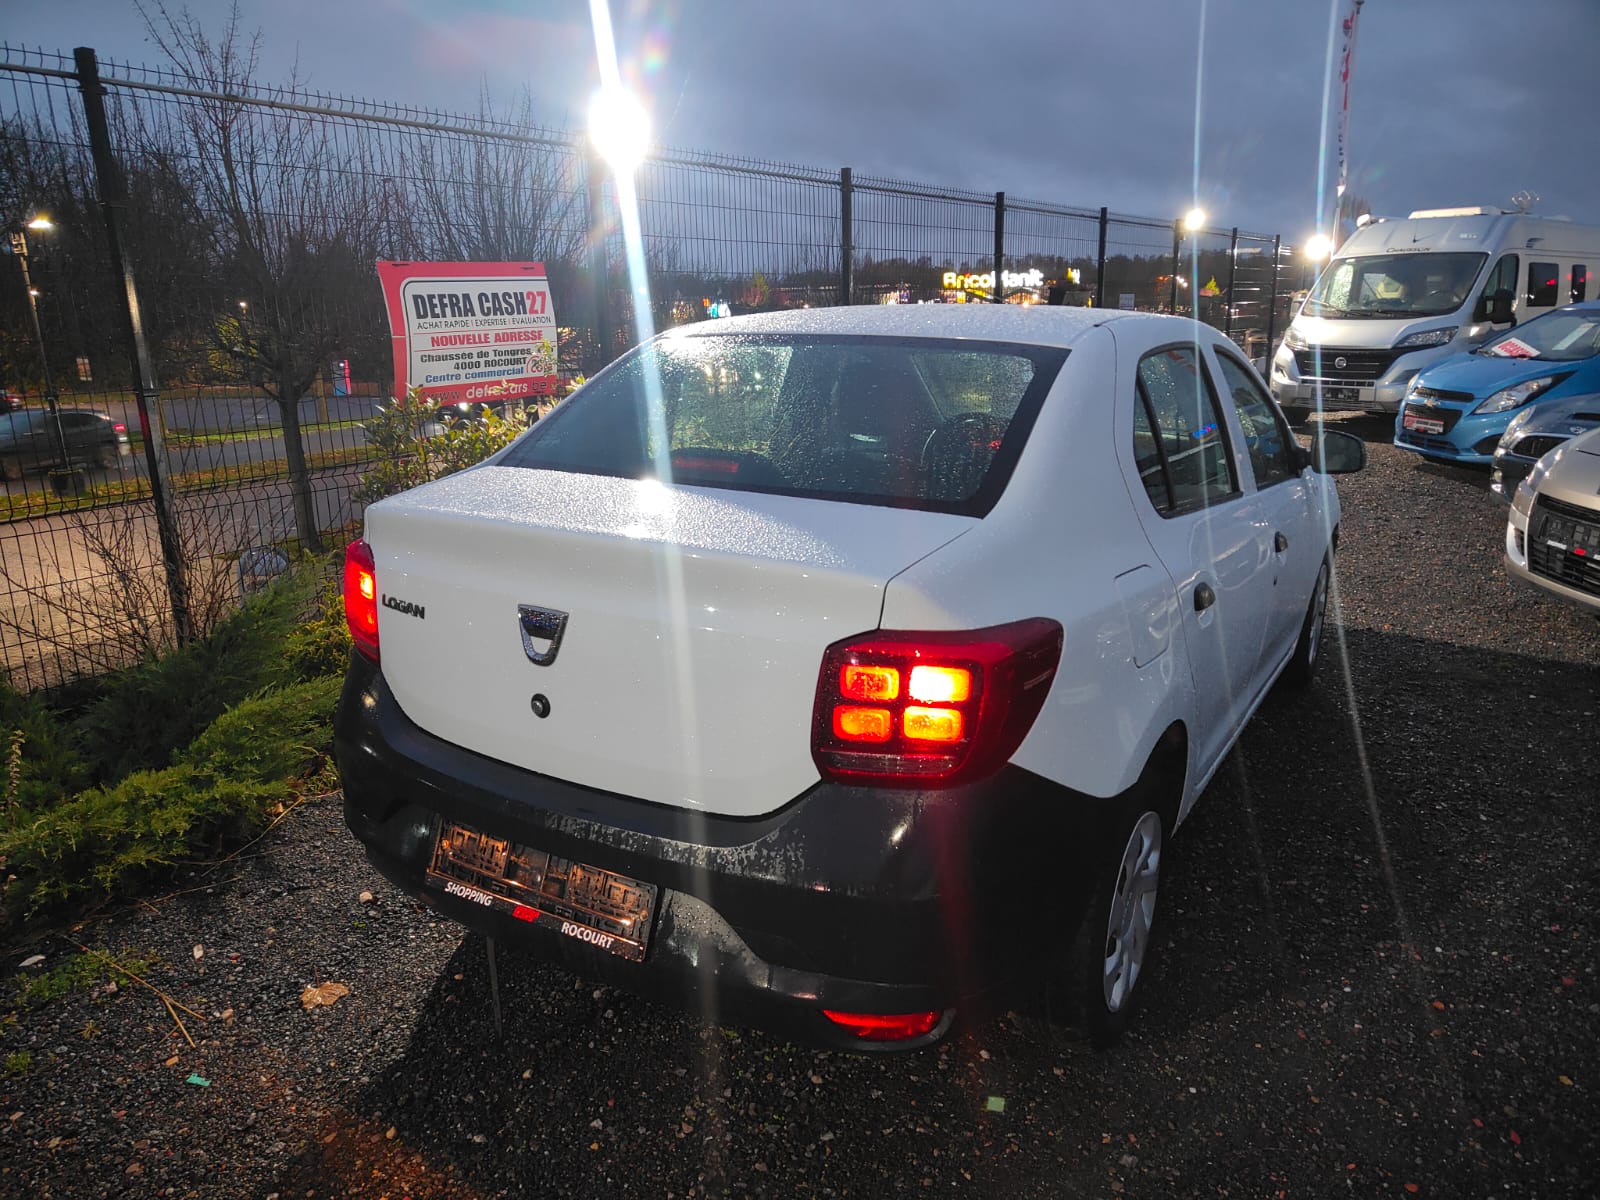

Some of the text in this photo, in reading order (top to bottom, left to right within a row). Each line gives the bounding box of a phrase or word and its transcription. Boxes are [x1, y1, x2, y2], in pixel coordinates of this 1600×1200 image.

[412, 292, 476, 319] DEFRA
[417, 320, 444, 330] ACHAT
[444, 319, 470, 328] RAPIDE
[475, 318, 507, 327] EXPERTISE
[431, 330, 543, 347] NOUVELLE ADRESSE
[453, 356, 527, 371] 4000 ROCOURT
[476, 350, 490, 360] de
[425, 366, 524, 384] Centre commercial
[382, 593, 425, 619] LOGAN
[444, 881, 494, 907] SHOPPING
[561, 921, 614, 949] ROCOURT
